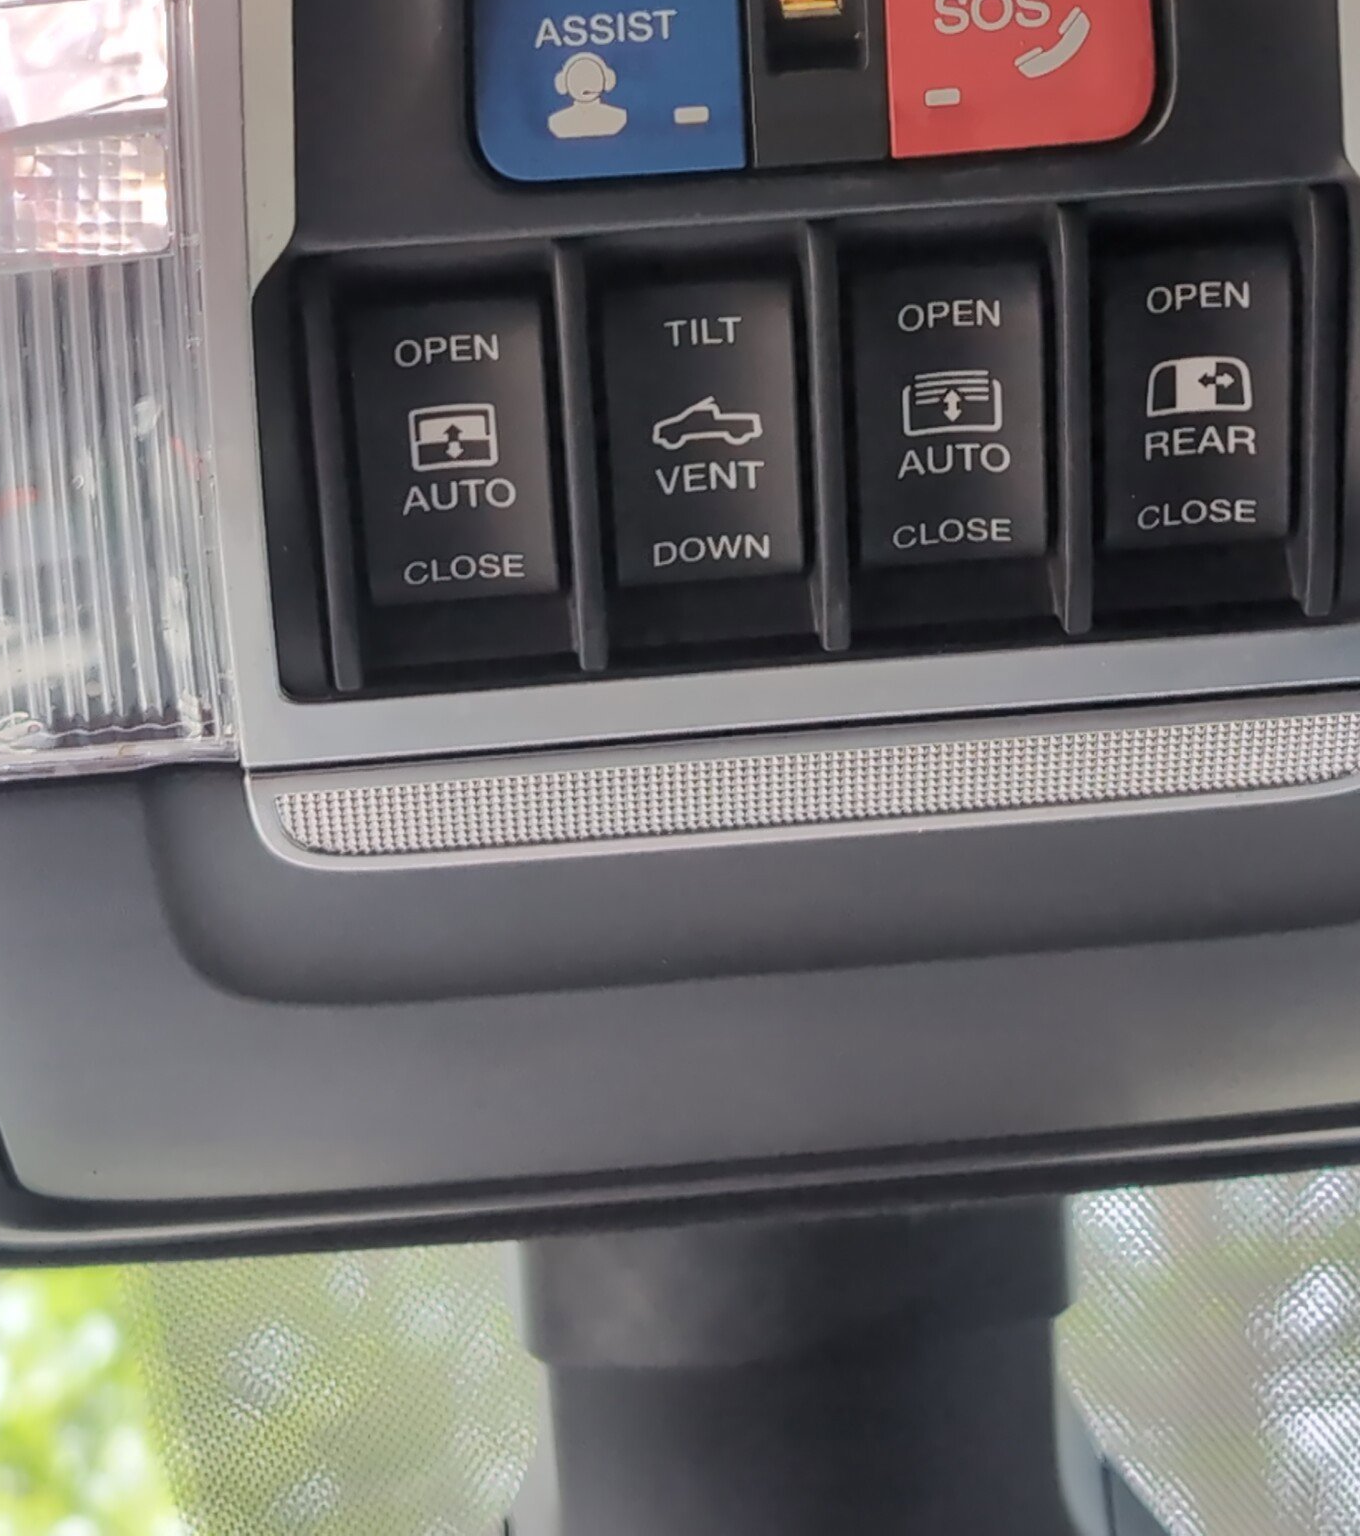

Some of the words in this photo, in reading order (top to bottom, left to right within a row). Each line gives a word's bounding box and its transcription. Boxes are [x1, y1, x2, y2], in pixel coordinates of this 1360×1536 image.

[535, 9, 678, 49] ASSIST
[1146, 281, 1250, 314] OPEN
[664, 316, 742, 347] TILT
[898, 299, 1001, 332] OPEN
[395, 333, 500, 367] OPEN
[1145, 425, 1256, 461] REAR
[898, 442, 1011, 479] AUTO
[655, 460, 765, 495] VENT
[403, 477, 517, 515] AUTO
[1137, 498, 1257, 529] CLOSE
[893, 517, 1012, 549] CLOSE
[653, 534, 771, 567] DOWN
[404, 553, 526, 585] CLOSE
